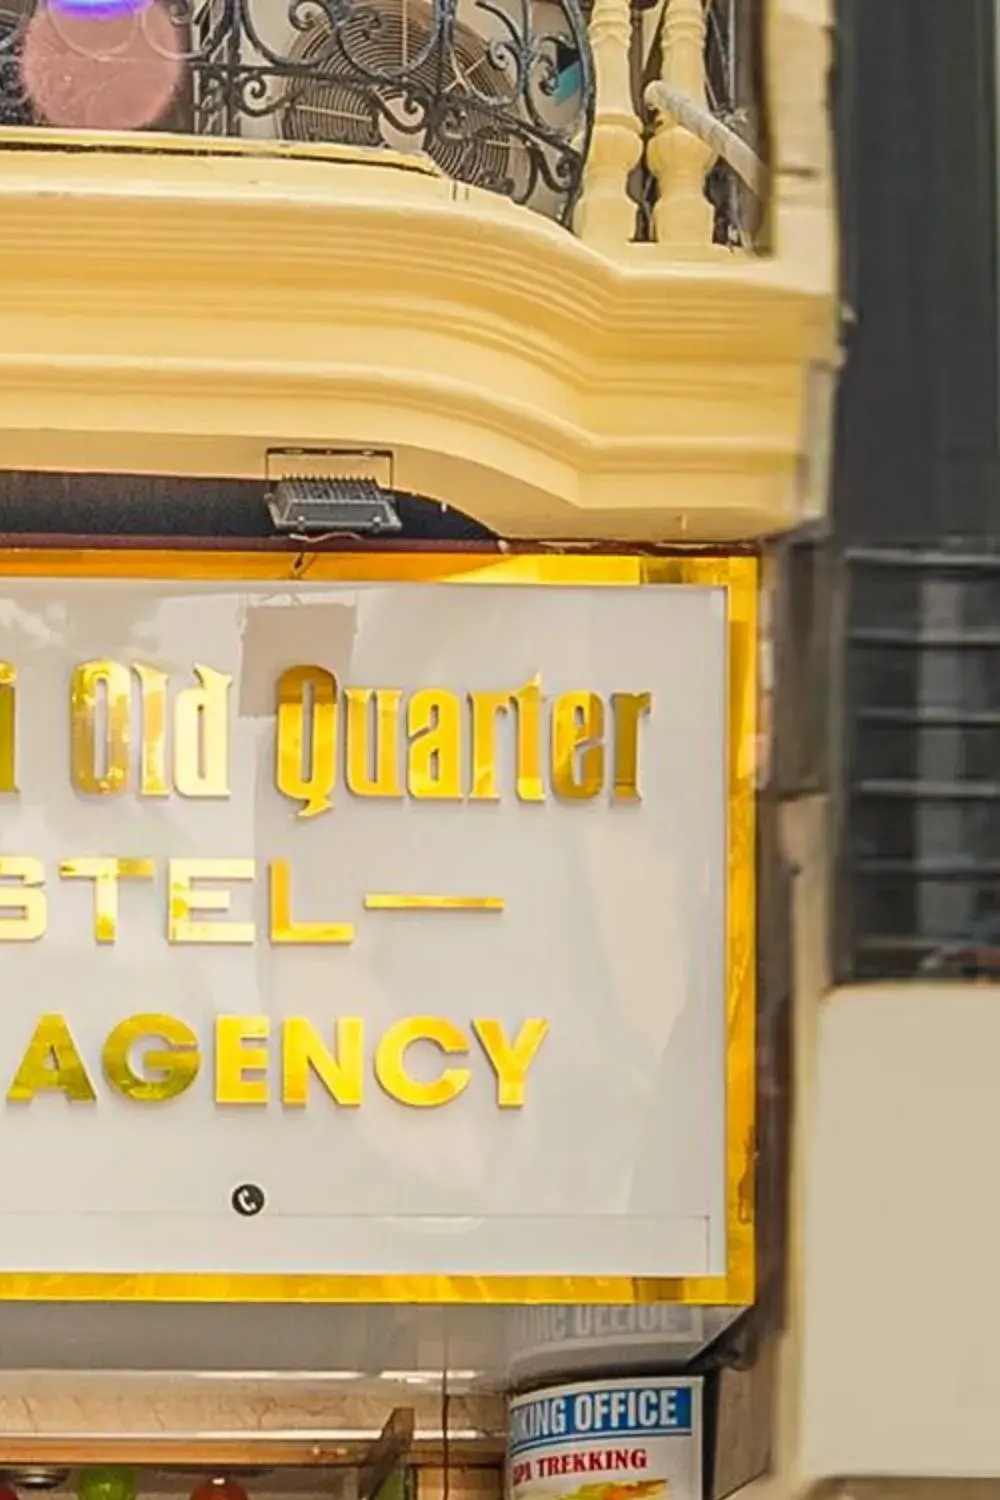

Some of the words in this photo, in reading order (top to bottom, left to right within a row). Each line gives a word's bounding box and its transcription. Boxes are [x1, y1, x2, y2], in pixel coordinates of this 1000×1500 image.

[69, 659, 233, 800] Old
[273, 663, 653, 819] Quarter
[5, 1013, 550, 1108] AGENCY
[574, 1390, 678, 1431] OFFICE
[536, 1449, 647, 1477] TREKKING
